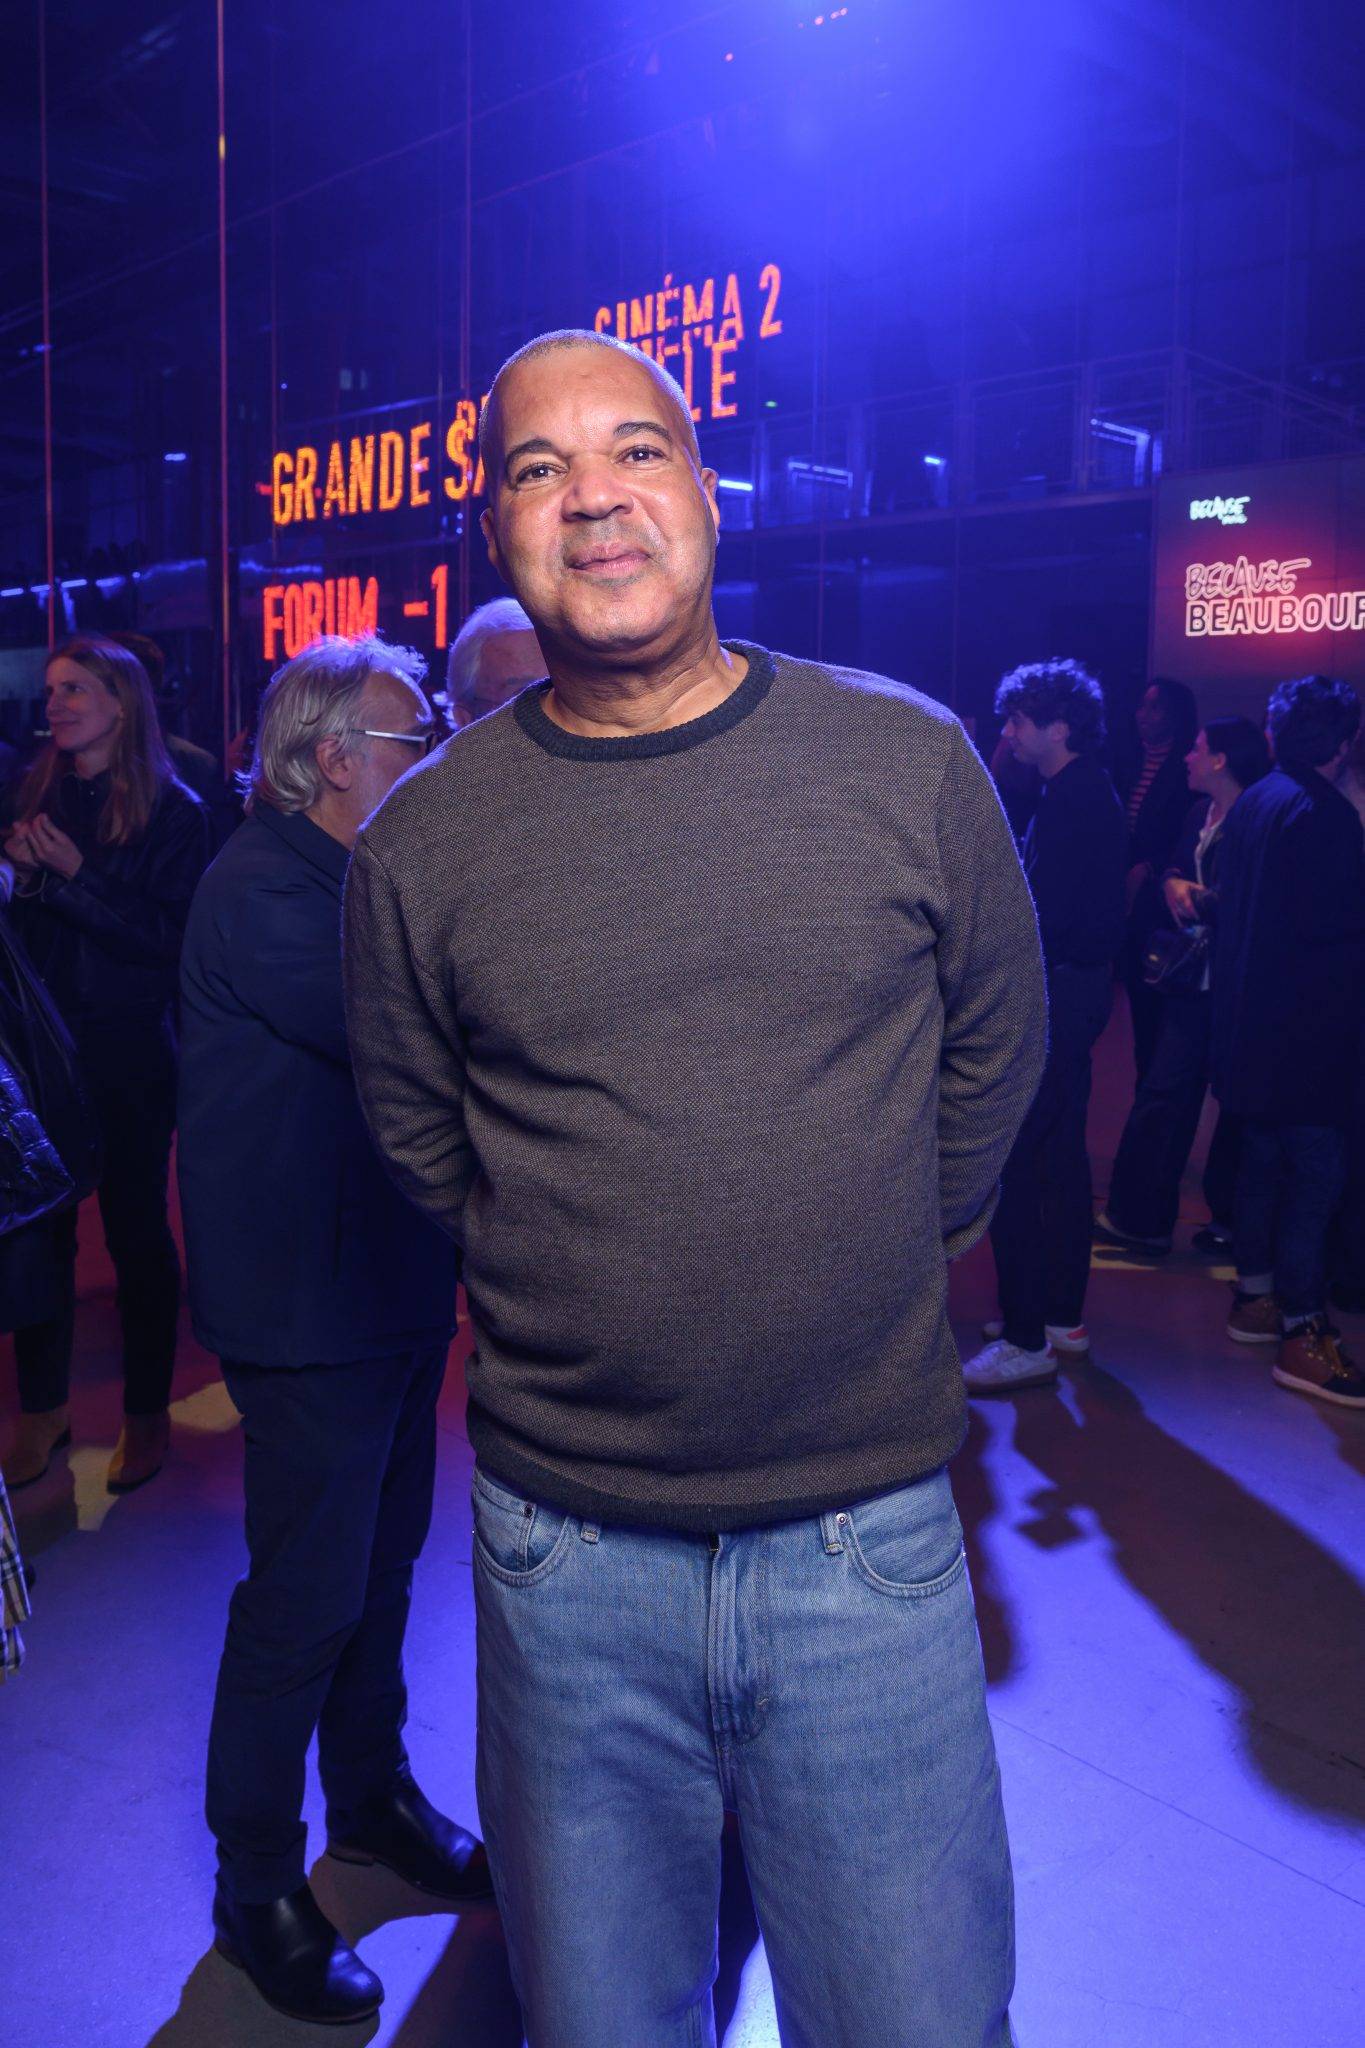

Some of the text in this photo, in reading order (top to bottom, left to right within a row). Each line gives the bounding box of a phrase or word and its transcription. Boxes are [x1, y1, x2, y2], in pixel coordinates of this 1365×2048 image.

[759, 263, 782, 339] 2
[273, 422, 431, 525] GRANDE
[1185, 555, 1312, 600] BECAUSE
[263, 576, 378, 660] FORUM
